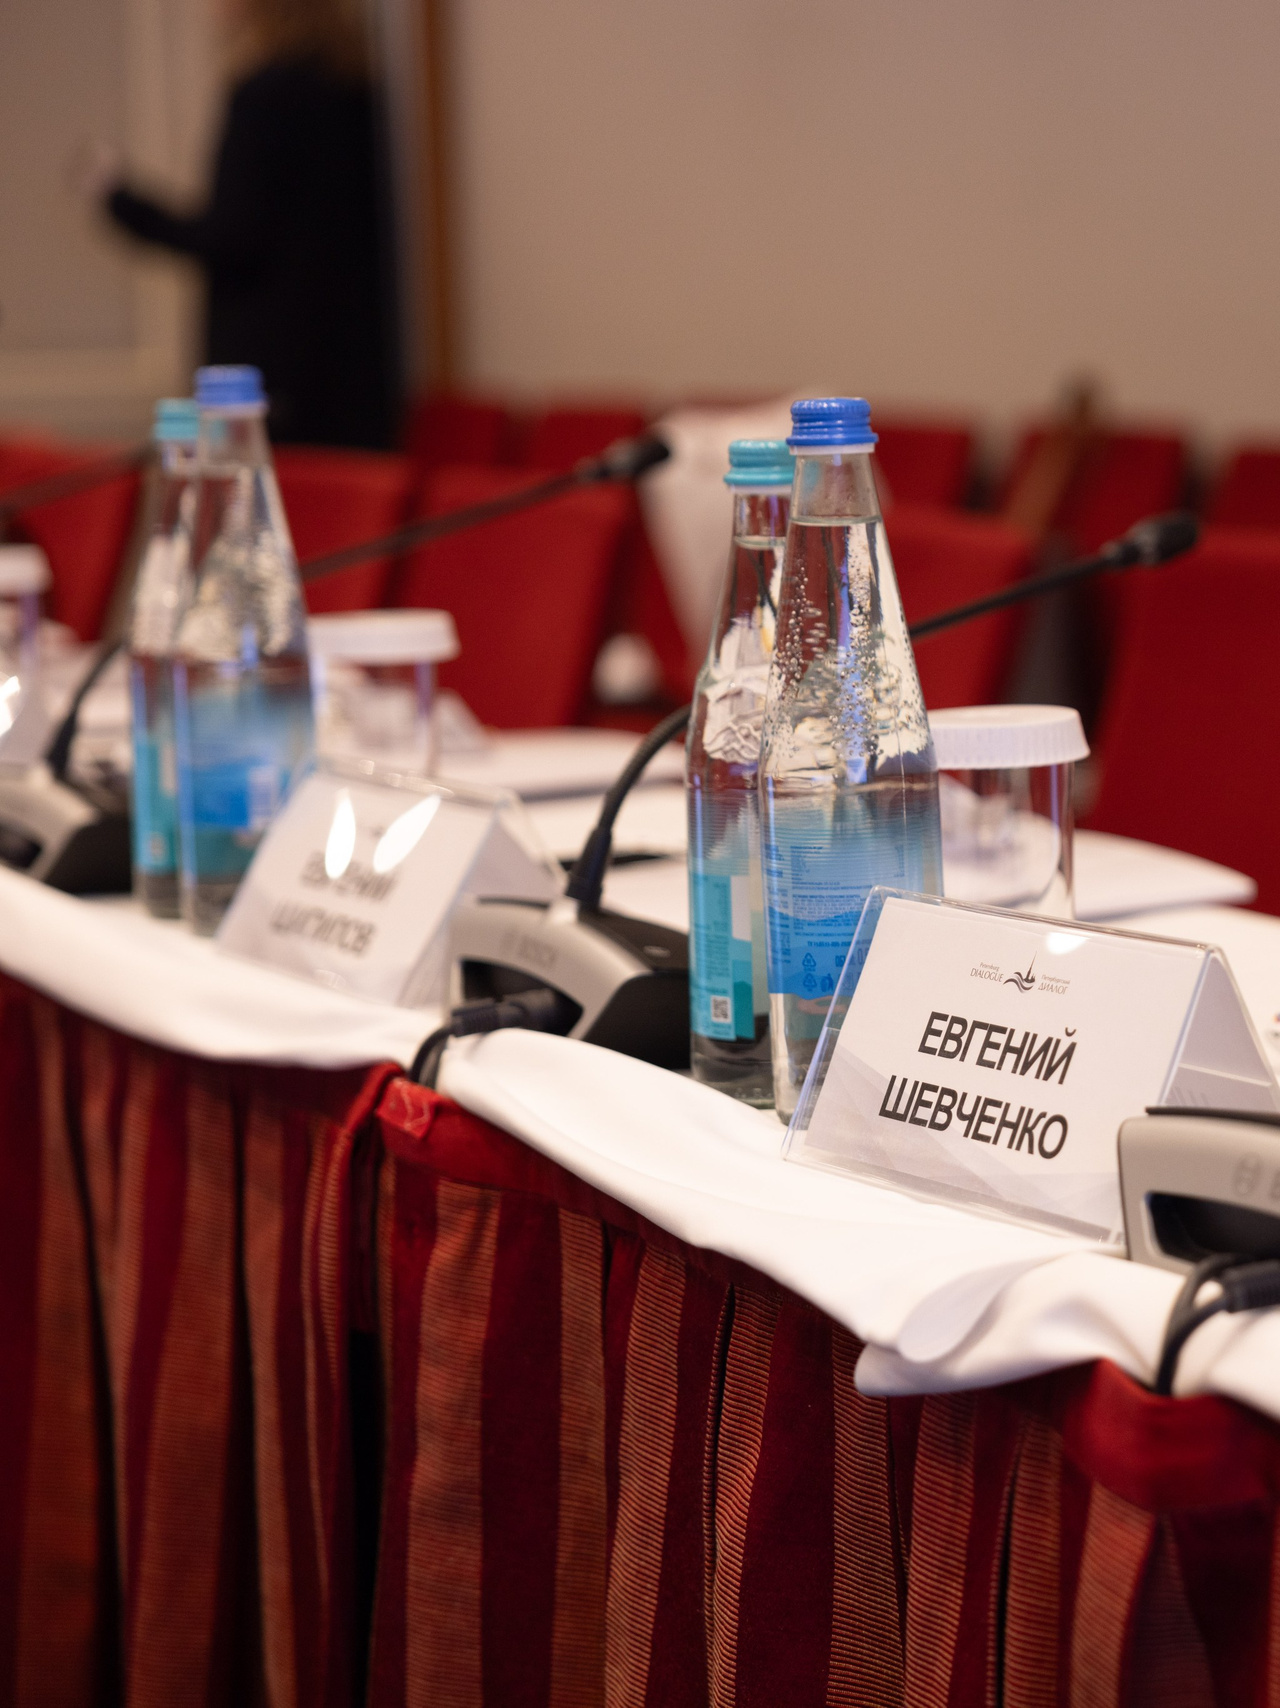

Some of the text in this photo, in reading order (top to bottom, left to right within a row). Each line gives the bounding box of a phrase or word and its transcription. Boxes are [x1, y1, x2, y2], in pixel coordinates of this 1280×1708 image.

[970, 968, 1004, 982] DIALOGUE
[1038, 982, 1068, 995] ДИАЛОГ
[918, 1011, 1078, 1085] ЕВГЕНИЙ
[878, 1074, 1070, 1160] ШЕВЧЕНКО
